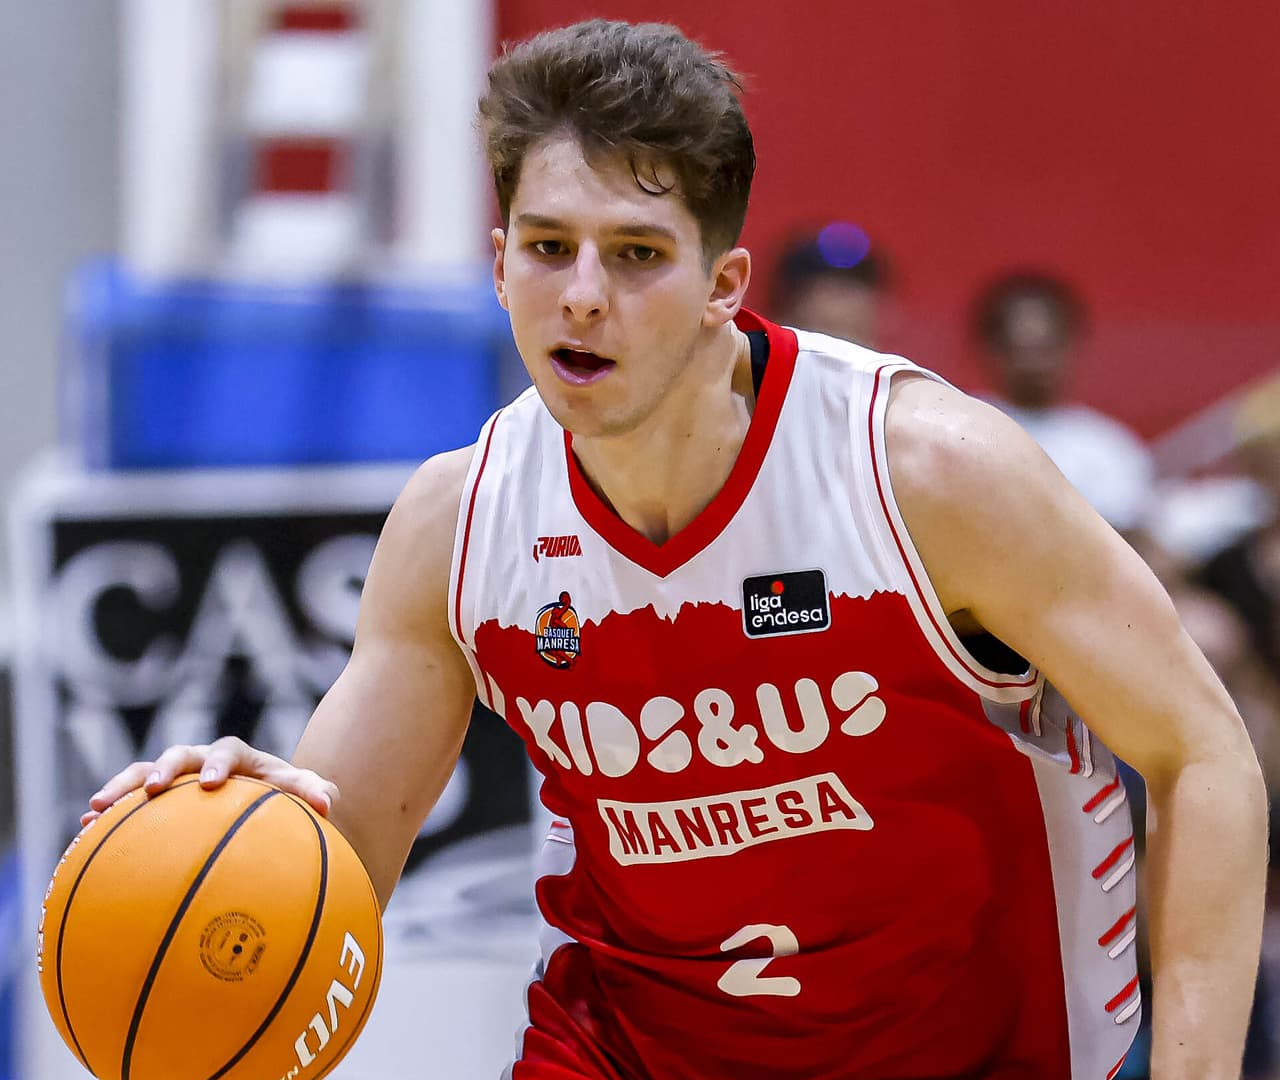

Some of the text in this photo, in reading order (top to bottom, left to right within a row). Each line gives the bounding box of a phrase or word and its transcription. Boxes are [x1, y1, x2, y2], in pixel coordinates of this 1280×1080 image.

[750, 593, 782, 613] liga
[752, 608, 823, 628] endesa
[537, 638, 580, 652] MANRESA
[517, 671, 886, 777] KIDS&US
[611, 780, 857, 856] MANRESA
[717, 923, 801, 996] 2
[294, 931, 366, 1068] EVO
